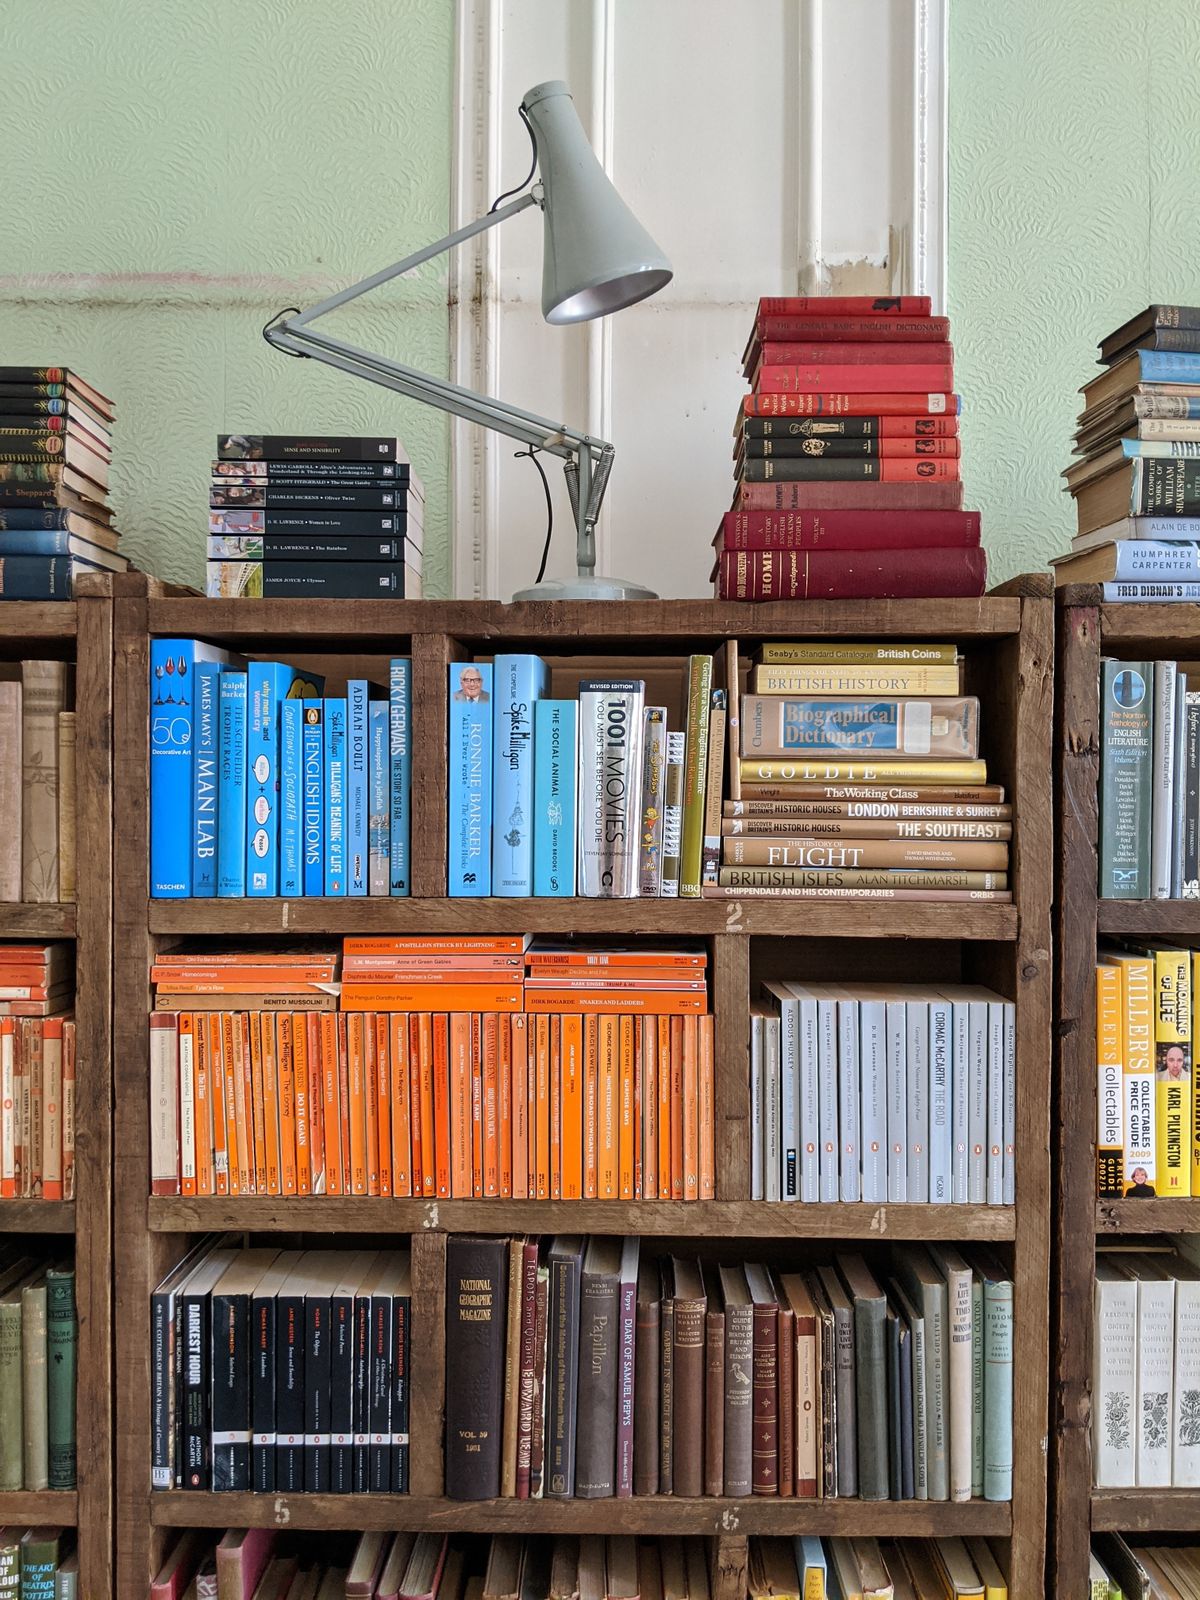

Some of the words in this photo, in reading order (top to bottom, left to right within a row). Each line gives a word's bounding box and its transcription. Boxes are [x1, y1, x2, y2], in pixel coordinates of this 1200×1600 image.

[1157, 465, 1162, 474] OF
[1166, 466, 1174, 504] WILLIAM
[1176, 459, 1185, 513] SHAKESPEARE
[763, 552, 772, 594] HOME
[1118, 586, 1137, 596] FRED
[1141, 586, 1182, 596] DIBNAH'S
[768, 650, 798, 659] Seaby's
[800, 650, 834, 658] Standard
[835, 650, 872, 659] Catalogue
[877, 649, 909, 659] British
[912, 650, 941, 659] Coins
[262, 681, 271, 698] why
[390, 666, 406, 702] RICKY
[700, 663, 709, 687] Going
[768, 678, 832, 689] BRITISH
[838, 678, 910, 690] HISTORY
[201, 676, 210, 710] JAMES
[329, 712, 342, 731] Spike
[354, 687, 362, 730] ADRIAN
[504, 703, 527, 731] Spike
[699, 706, 708, 726] Song:
[785, 703, 896, 727] Biographical
[202, 713, 212, 745] MAY'S
[390, 705, 406, 755] GERVAIS
[608, 700, 626, 747] 1001
[785, 725, 876, 746] Dictionary
[328, 731, 344, 757] Milligan
[354, 736, 362, 771] BOULT
[470, 723, 482, 787] RONNIE
[503, 732, 530, 770] Milligan
[698, 728, 707, 755] English
[198, 758, 214, 812] MAN
[306, 742, 319, 804] ENGLISH
[330, 762, 342, 803] MILLIGAN'S
[697, 758, 706, 794] Furniture
[393, 796, 402, 804] SO
[606, 757, 625, 843] MOVIES
[775, 804, 810, 813] HISTORIC
[811, 805, 842, 814] HOUSES
[848, 804, 898, 816] LONDON
[902, 806, 954, 816] BERKSHIRE
[956, 808, 963, 816] &
[966, 807, 1001, 817] SURREY
[306, 809, 320, 864] IDIOMS
[331, 807, 341, 840] MEANING
[470, 793, 481, 858] BARKER
[897, 823, 921, 836] THE
[925, 824, 1001, 837] SOUTHEAST
[198, 820, 214, 858] LAB
[331, 856, 341, 873] LIFE
[768, 847, 863, 866] FLIGHT
[730, 871, 798, 886] BRITISH
[801, 872, 843, 886] ISLES
[856, 874, 888, 884] ALAN
[891, 875, 968, 885] TITCHMARSH
[818, 888, 894, 896] CONTEMPORARIES
[725, 902, 743, 932] 2
[1161, 976, 1173, 989] OF
[1177, 963, 1186, 979] THE
[1102, 969, 1117, 1061] MILLER'S
[1128, 965, 1148, 1069] MILLER'S
[1160, 991, 1176, 1023] LIFE
[1176, 981, 1188, 1035] MOANING
[935, 1012, 945, 1044] CORMAC
[935, 1046, 945, 1086] McCARTHY
[298, 1093, 304, 1105] DO
[936, 1090, 944, 1103] THE
[1105, 1067, 1120, 1143] collectables
[1130, 1081, 1138, 1110] PRICE
[1167, 1087, 1181, 1110] KARL
[298, 1108, 304, 1116] IT
[936, 1106, 944, 1126] ROAD
[1141, 1081, 1150, 1148] COLLECTABLES
[1131, 1113, 1139, 1148] GUIDE
[1167, 1114, 1181, 1167] PILKINGTON
[460, 1279, 492, 1291] NATIONAL
[526, 1260, 535, 1301] TEAPOTS
[459, 1309, 492, 1321] MAGAZINE
[624, 1291, 633, 1310] Pepys
[189, 1304, 200, 1353] DARKEST
[624, 1319, 632, 1345] DIARY
[591, 1315, 608, 1374] Papillon
[624, 1348, 632, 1360] OF
[189, 1355, 200, 1384] HOUR
[520, 1369, 533, 1431] EDWARD
[519, 1435, 530, 1468] LEAR
[274, 1498, 290, 1524] 5
[23, 1580, 54, 1589] BEATRIX
[23, 1591, 54, 1600] POTTER
